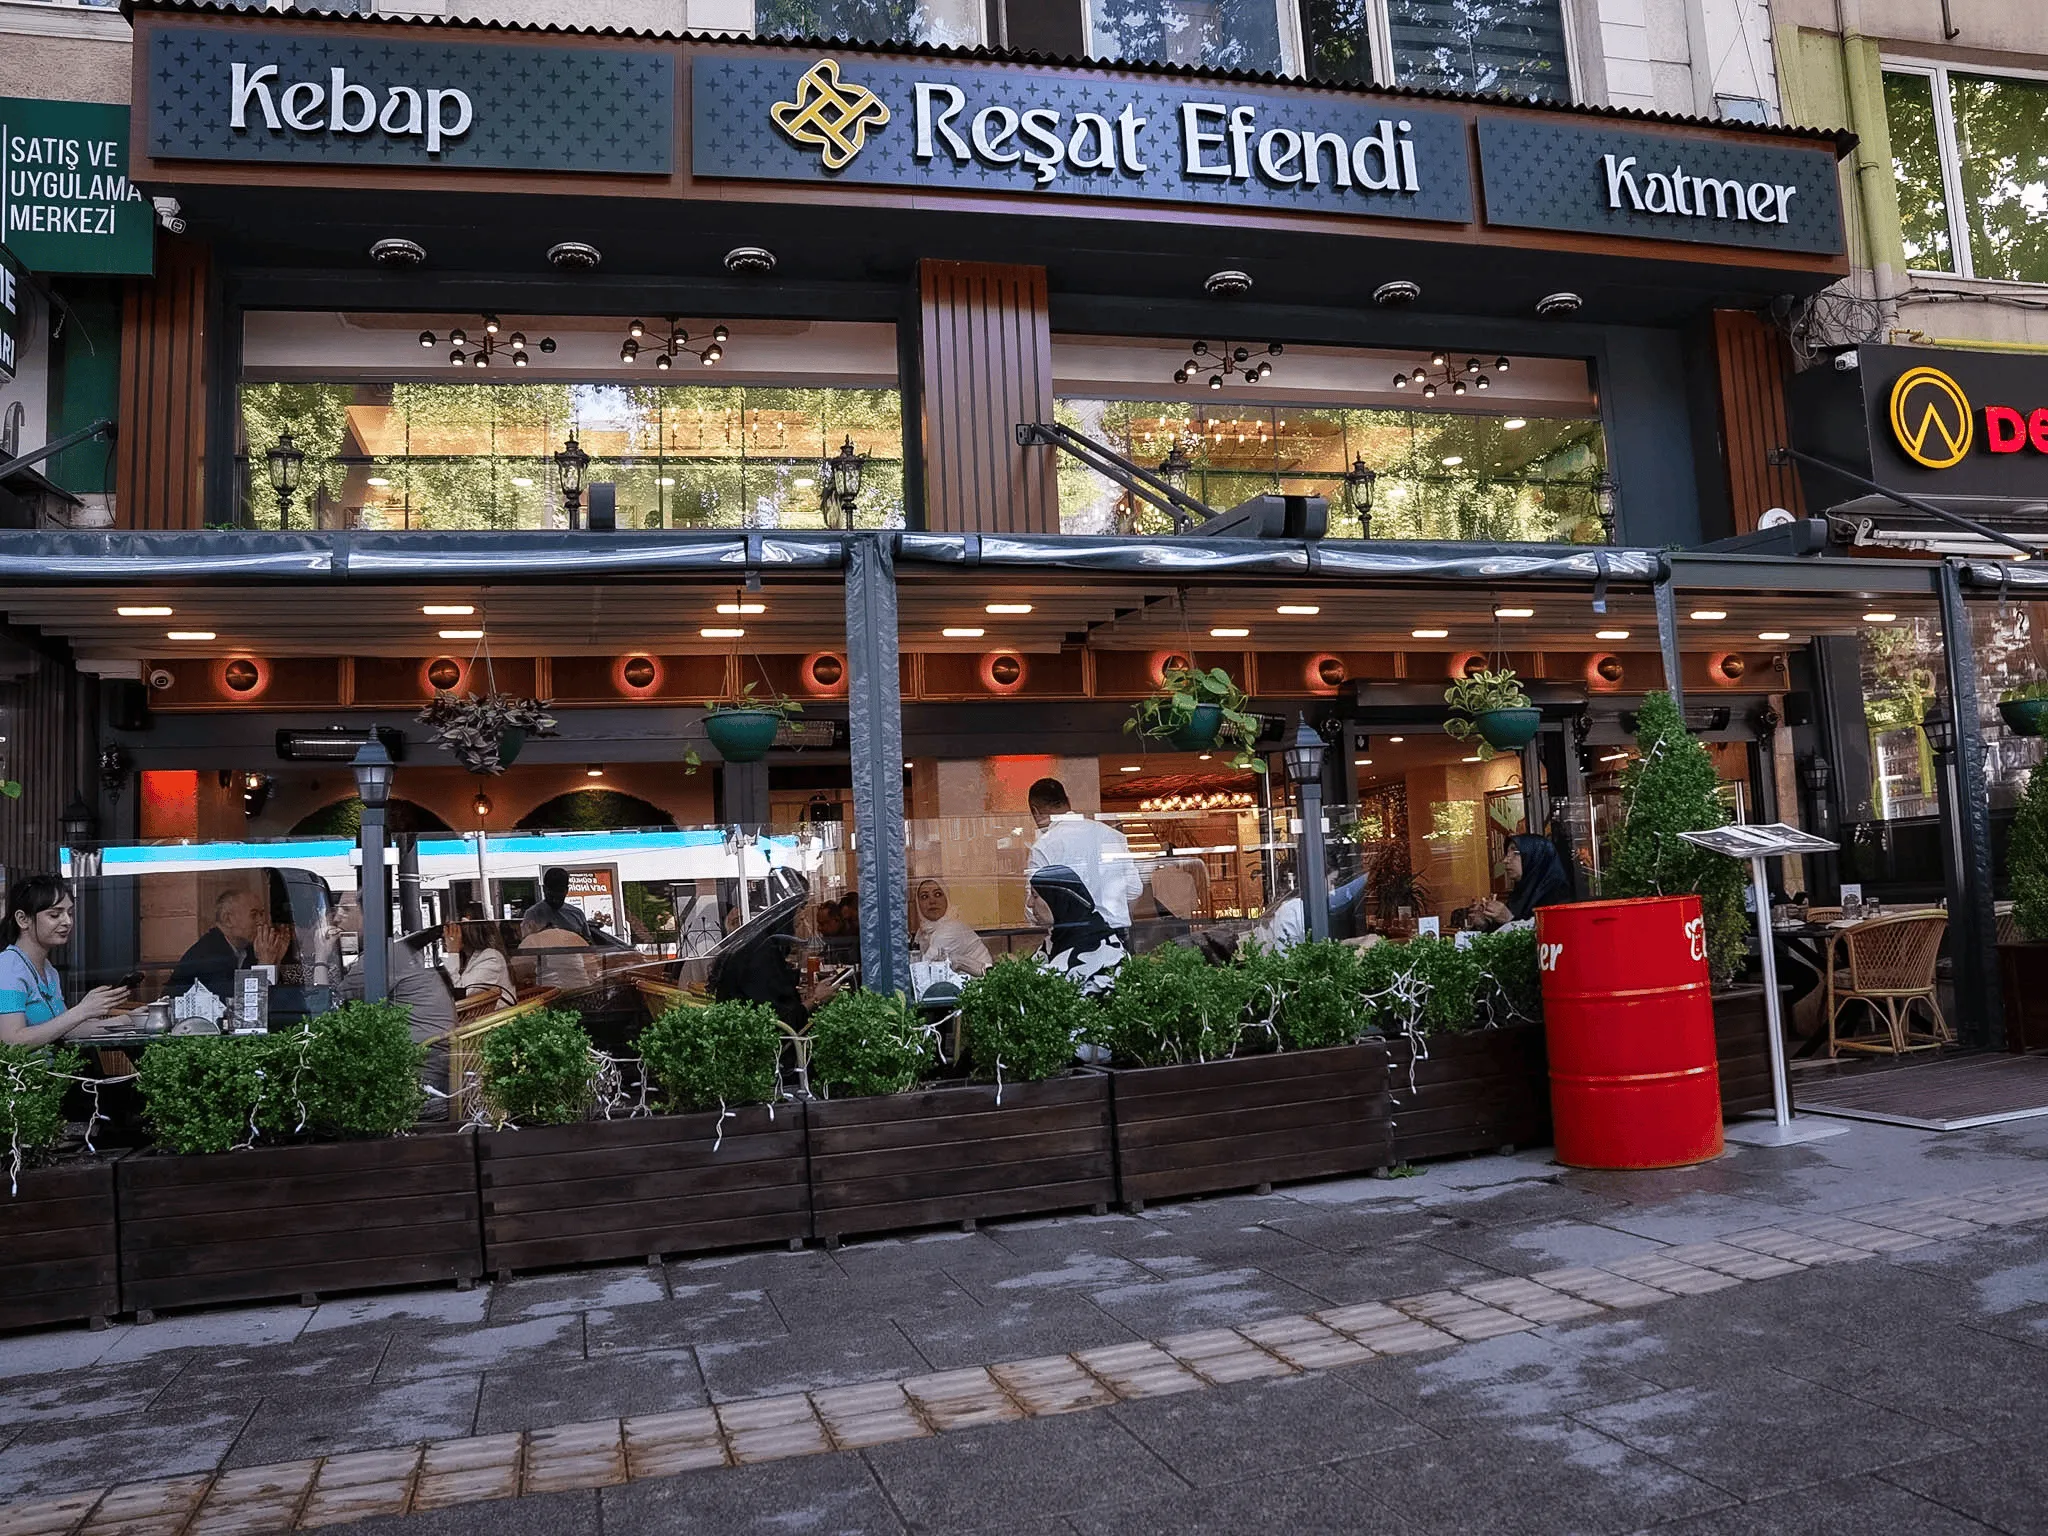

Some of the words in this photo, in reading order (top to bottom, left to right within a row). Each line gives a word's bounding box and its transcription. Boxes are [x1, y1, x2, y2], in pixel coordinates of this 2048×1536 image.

[230, 63, 472, 152] Kebap
[11, 137, 80, 170] SATIŞ
[88, 140, 118, 168] VE
[914, 82, 1147, 182] Reşat
[1181, 102, 1420, 192] Efendi
[11, 170, 142, 202] UYGULAMA
[1604, 154, 1796, 224] Katmer
[10, 204, 115, 235] MERKEZİ
